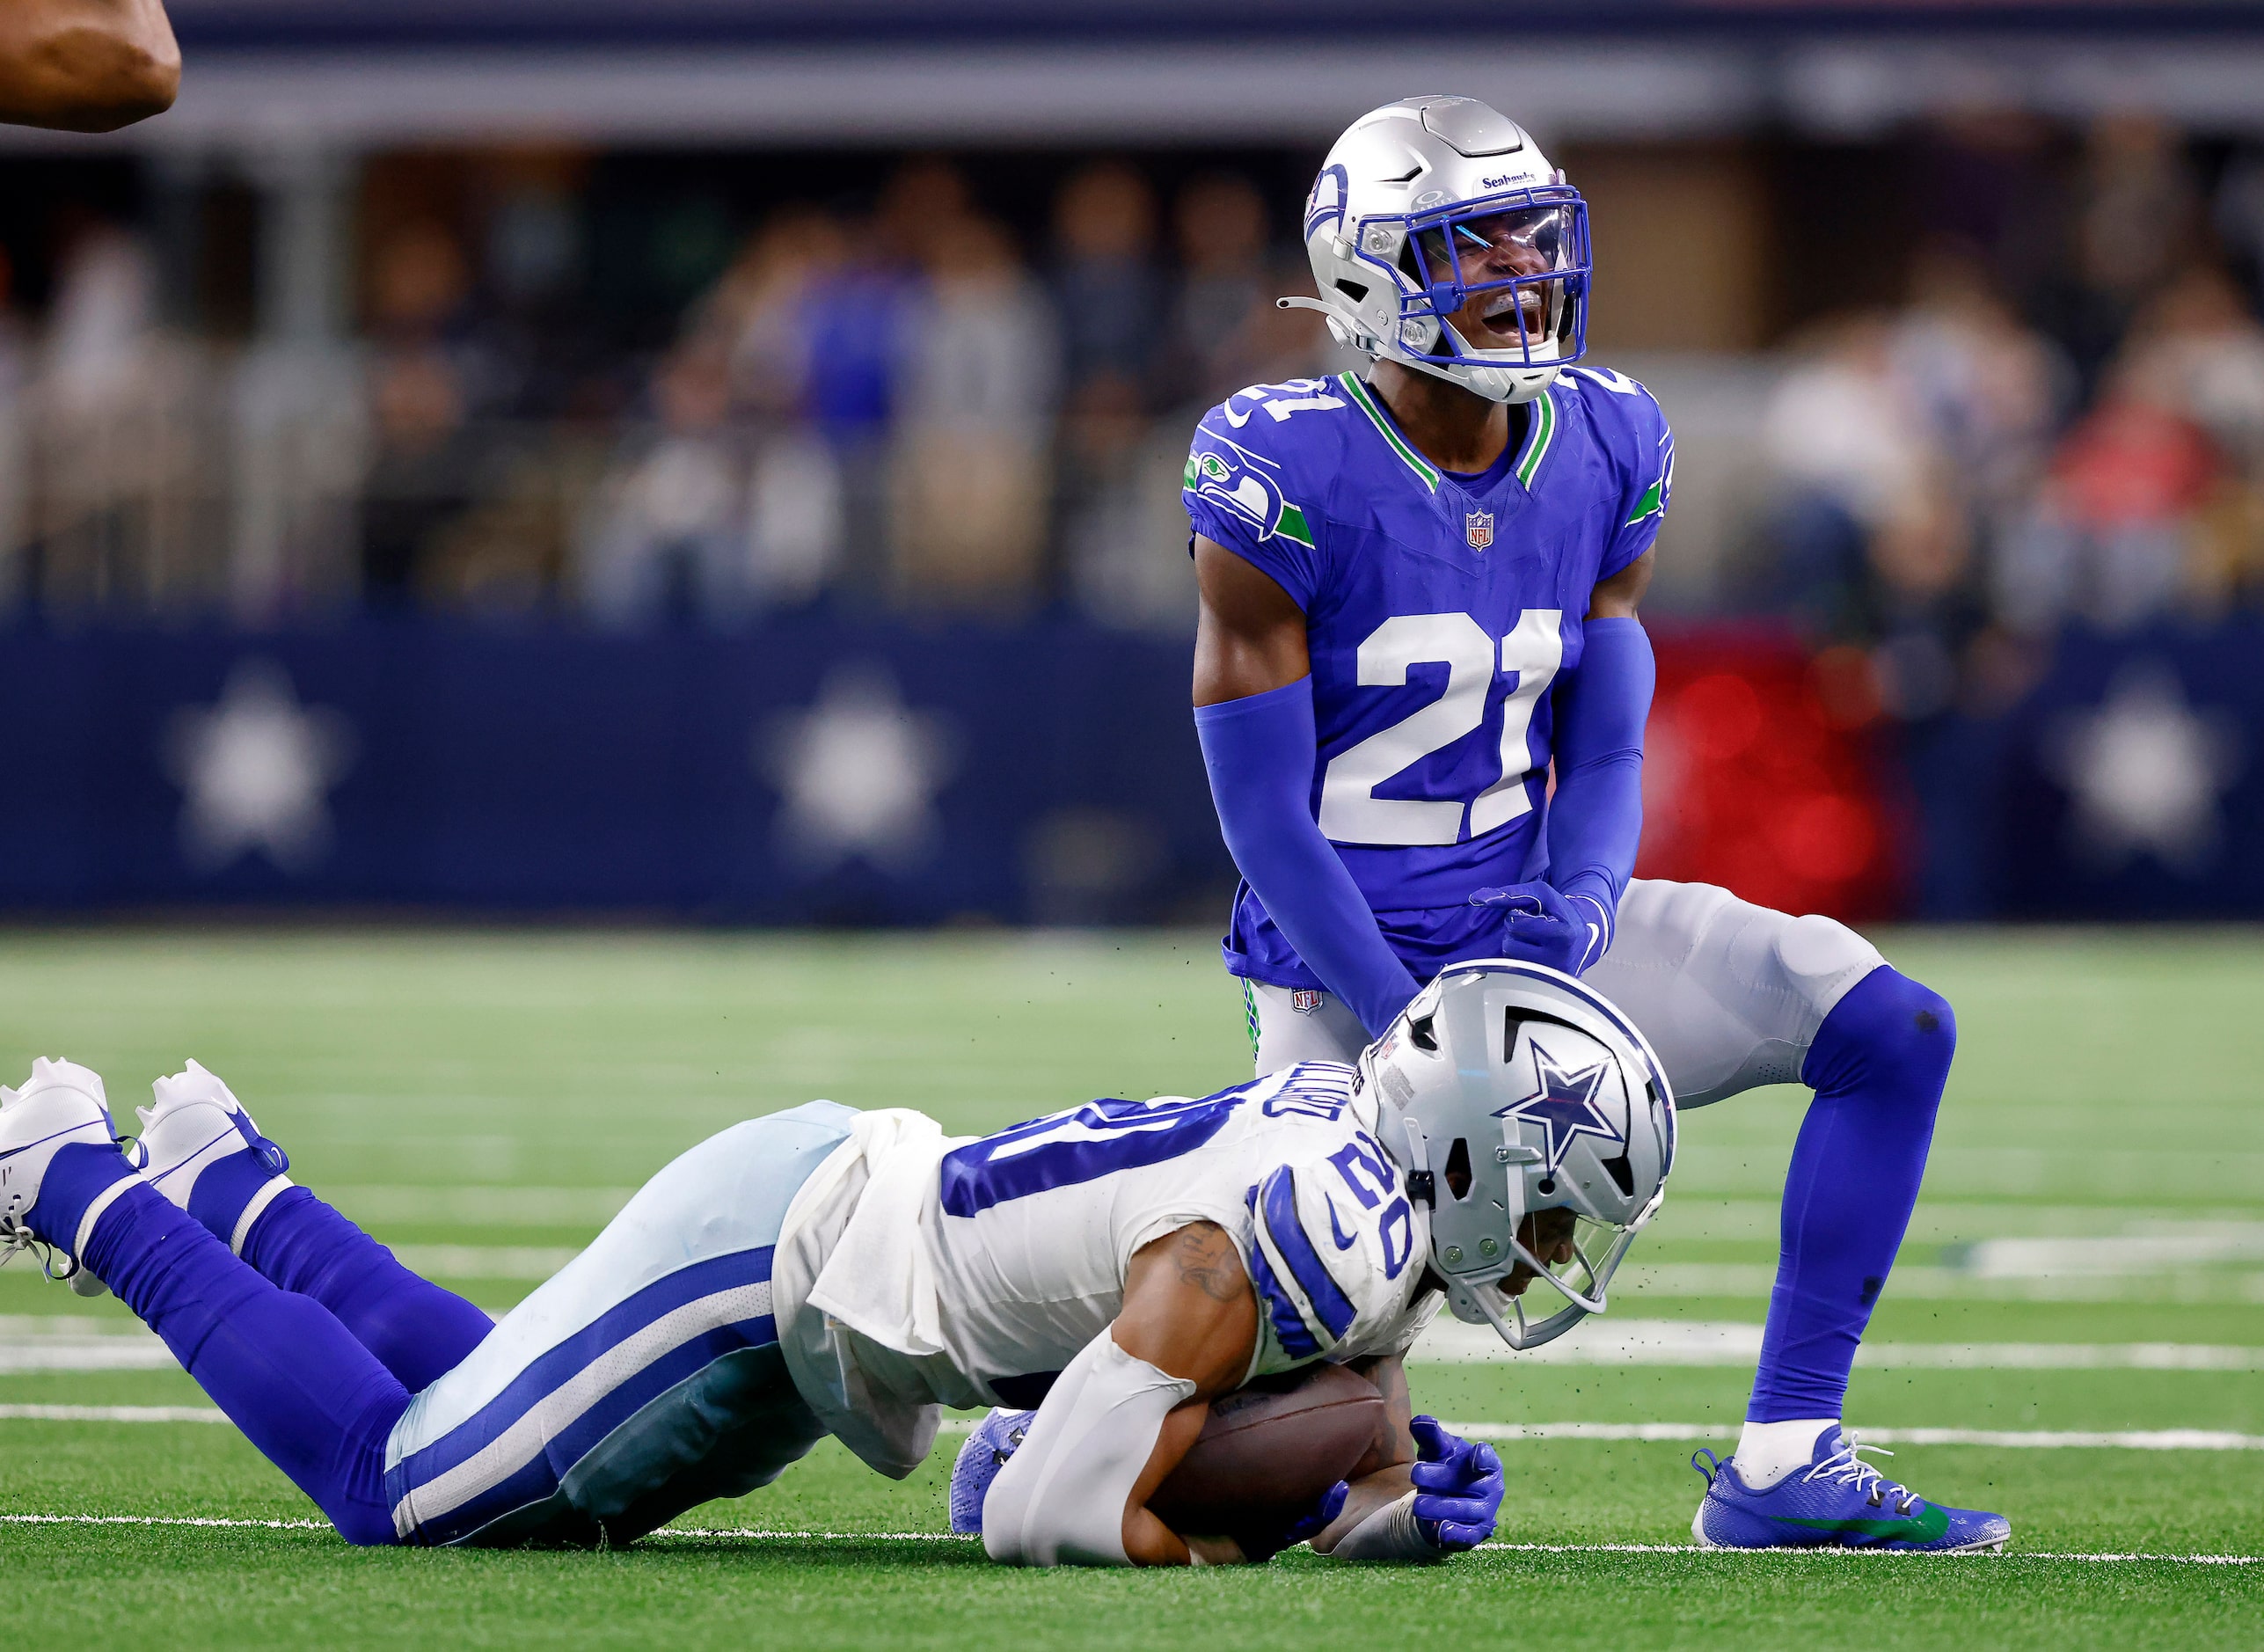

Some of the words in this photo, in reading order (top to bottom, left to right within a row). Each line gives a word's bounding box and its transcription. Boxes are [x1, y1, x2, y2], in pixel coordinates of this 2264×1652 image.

[1482, 172, 1536, 188] Seahawks
[1232, 378, 1347, 423] 21
[1471, 529, 1489, 545] NFL
[1318, 609, 1563, 845] 21
[1295, 990, 1318, 1008] NFL
[1262, 1060, 1355, 1122] LLARD
[1326, 1130, 1413, 1281] 20
